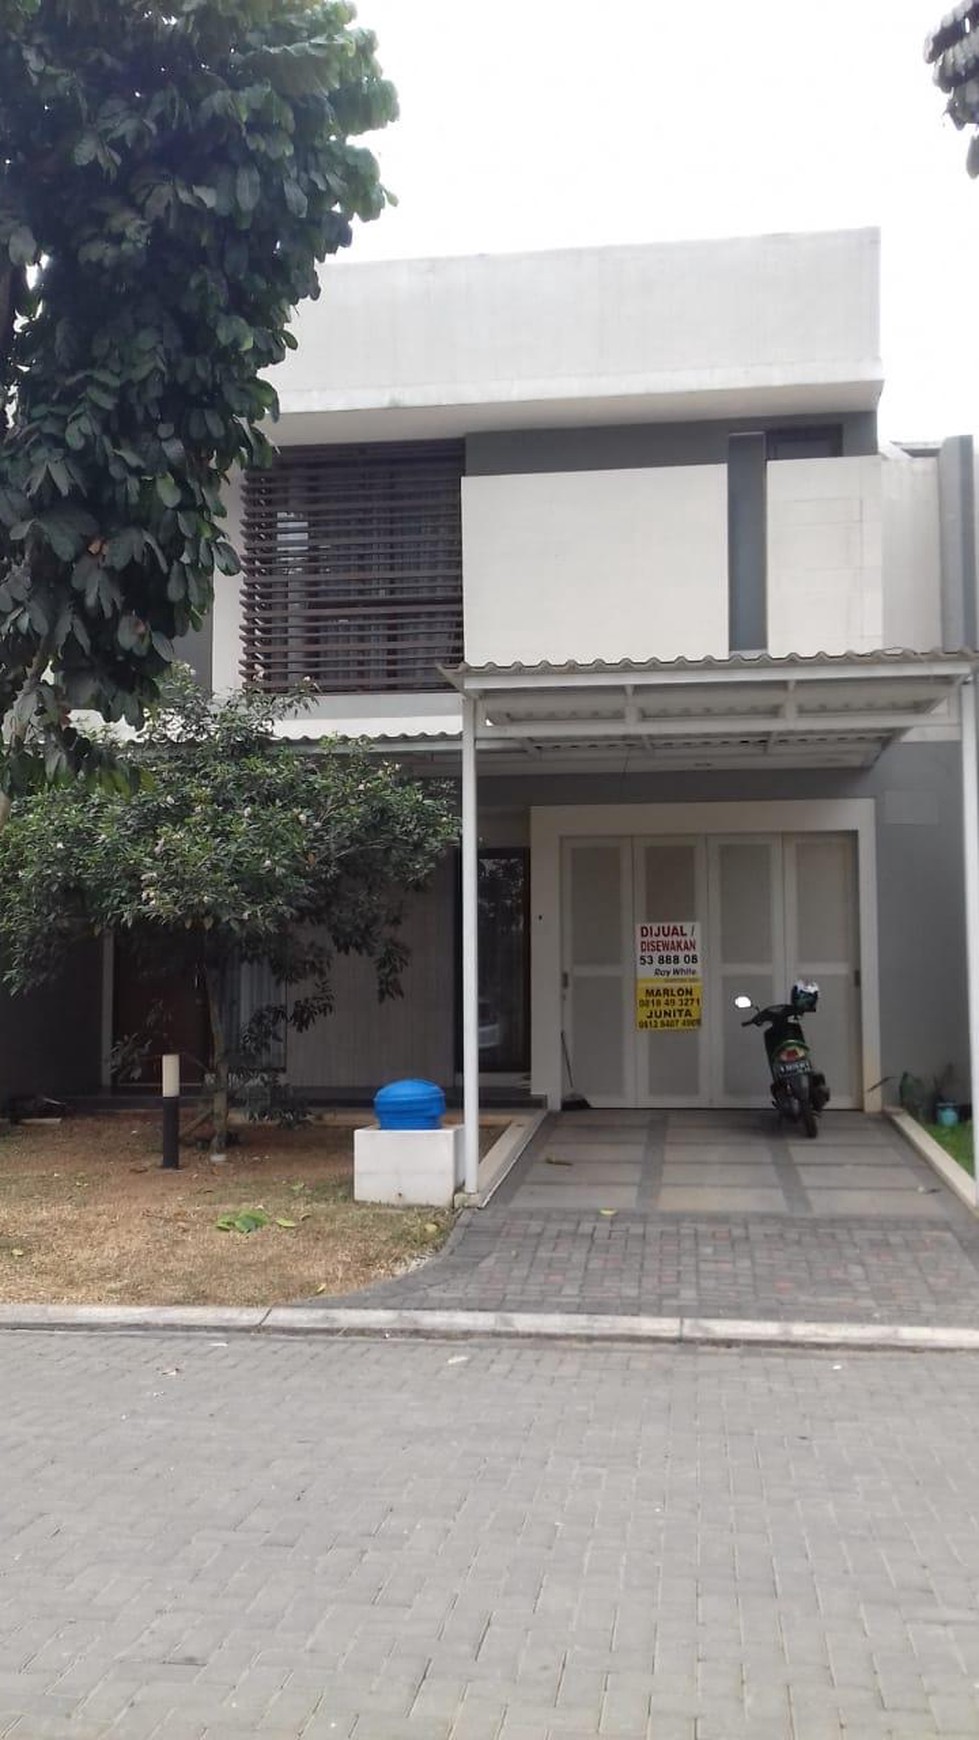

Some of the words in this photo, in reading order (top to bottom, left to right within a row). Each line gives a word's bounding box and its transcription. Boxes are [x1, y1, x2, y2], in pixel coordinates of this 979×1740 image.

[641, 925, 687, 937] DIJUAL
[640, 939, 696, 952] DISEWAKAN
[640, 955, 653, 965] 53
[658, 954, 679, 965] 888
[654, 968, 671, 977] Ray
[673, 967, 696, 976] White
[645, 987, 693, 997] MARLON
[647, 1008, 692, 1018] JUNITA
